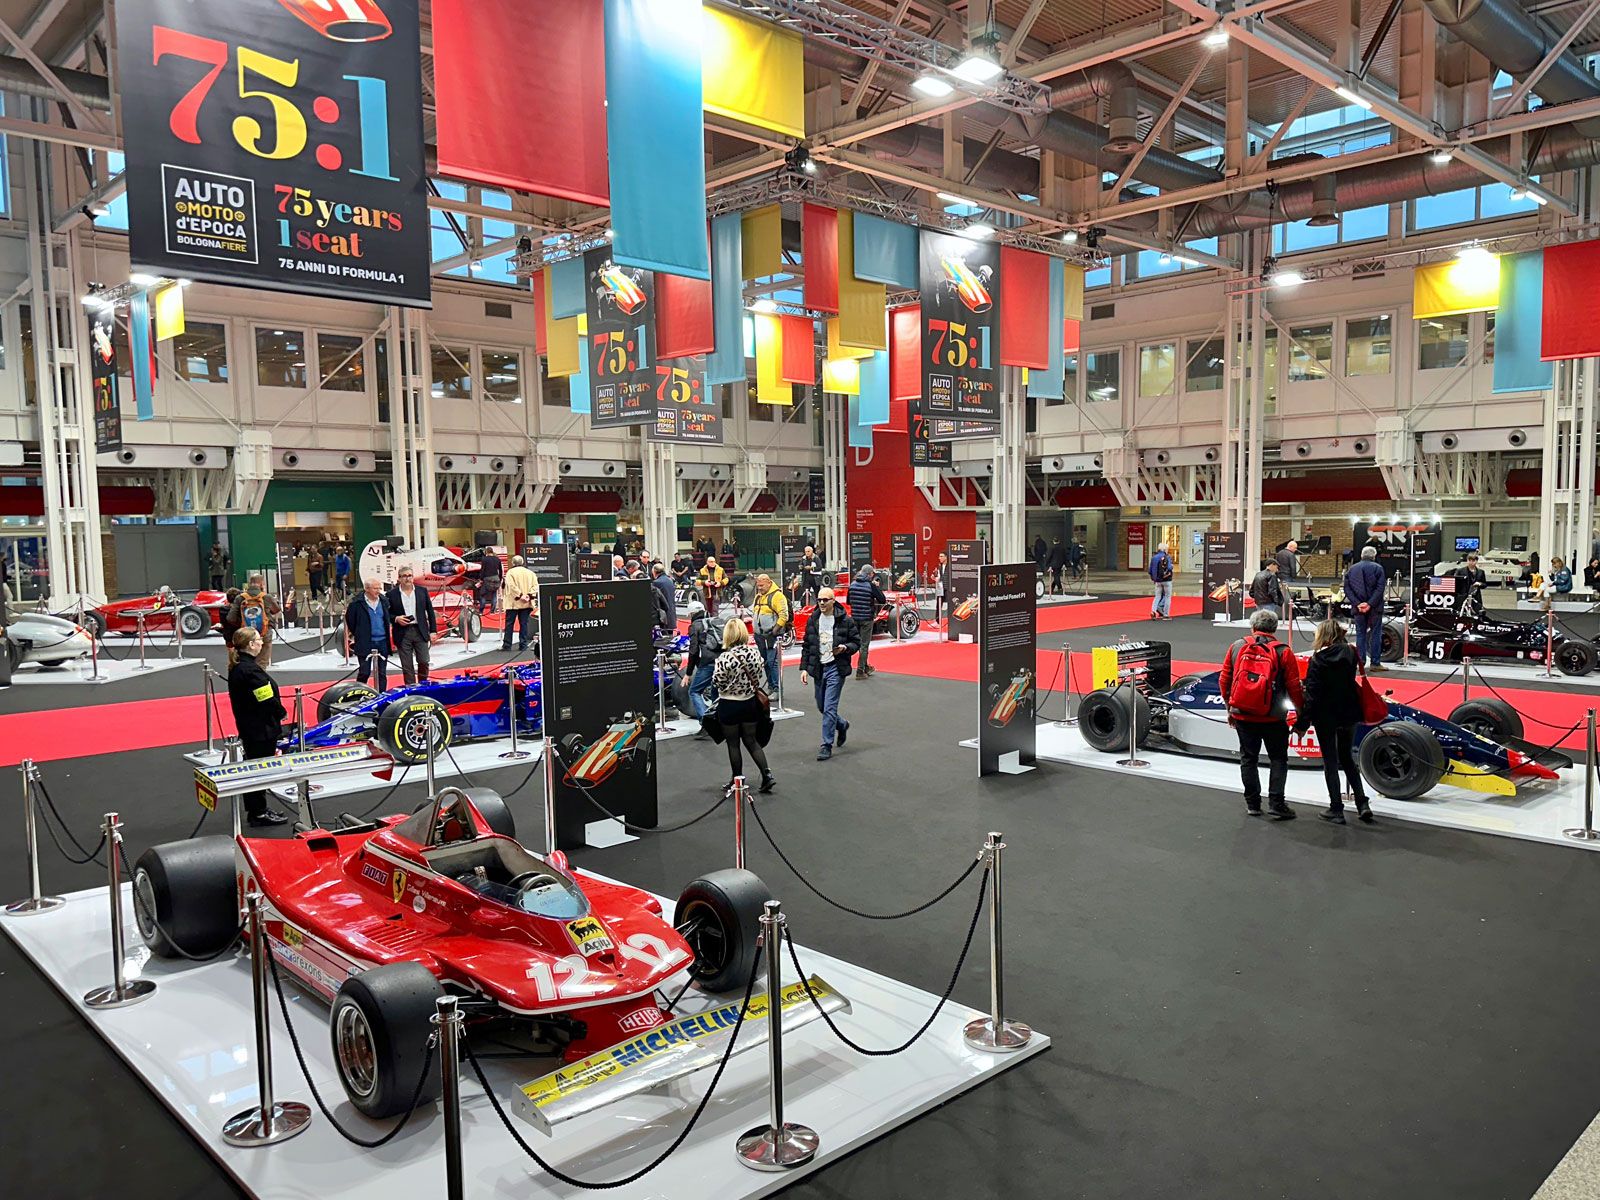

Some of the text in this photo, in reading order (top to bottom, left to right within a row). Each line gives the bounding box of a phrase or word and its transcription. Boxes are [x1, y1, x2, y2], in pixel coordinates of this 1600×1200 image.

[153, 25, 400, 182] 75:1
[175, 178, 245, 208] AUTO
[187, 201, 234, 220] MOTO
[274, 184, 403, 231] 75 years
[176, 217, 247, 238] d'EPOCA
[177, 235, 247, 252] BOLOGNAFIERE
[276, 219, 364, 258] 1 seat
[278, 258, 404, 284] 75 ANNI DI FORMULA 1
[594, 324, 649, 376] 75:1
[928, 319, 993, 370] 75:1
[619, 382, 652, 397] 75 years
[656, 365, 715, 405] 75:1
[932, 378, 950, 388] AUTO
[957, 377, 993, 393] 75 years
[599, 388, 614, 398] AUTO
[624, 395, 640, 407] seat
[963, 393, 981, 404] seat
[657, 411, 675, 419] AUTO
[681, 410, 717, 423] 75 years
[687, 423, 705, 432] seat
[922, 525, 933, 541] D
[556, 594, 584, 610] 75:1
[595, 593, 615, 602] years
[558, 619, 609, 630] Ferrari 312 T4
[558, 630, 574, 638] 1979
[1426, 641, 1445, 659] 15
[1104, 679, 1116, 688] 14
[346, 689, 376, 698] ZERO
[207, 750, 361, 778] MICHELIN MICHELIN
[364, 865, 387, 885] FIAT
[584, 939, 610, 954] Agip
[619, 934, 689, 972] 12
[525, 954, 597, 1001] 12
[623, 1007, 661, 1028] HEUER
[555, 1005, 741, 1094] Agip MICHELIN
